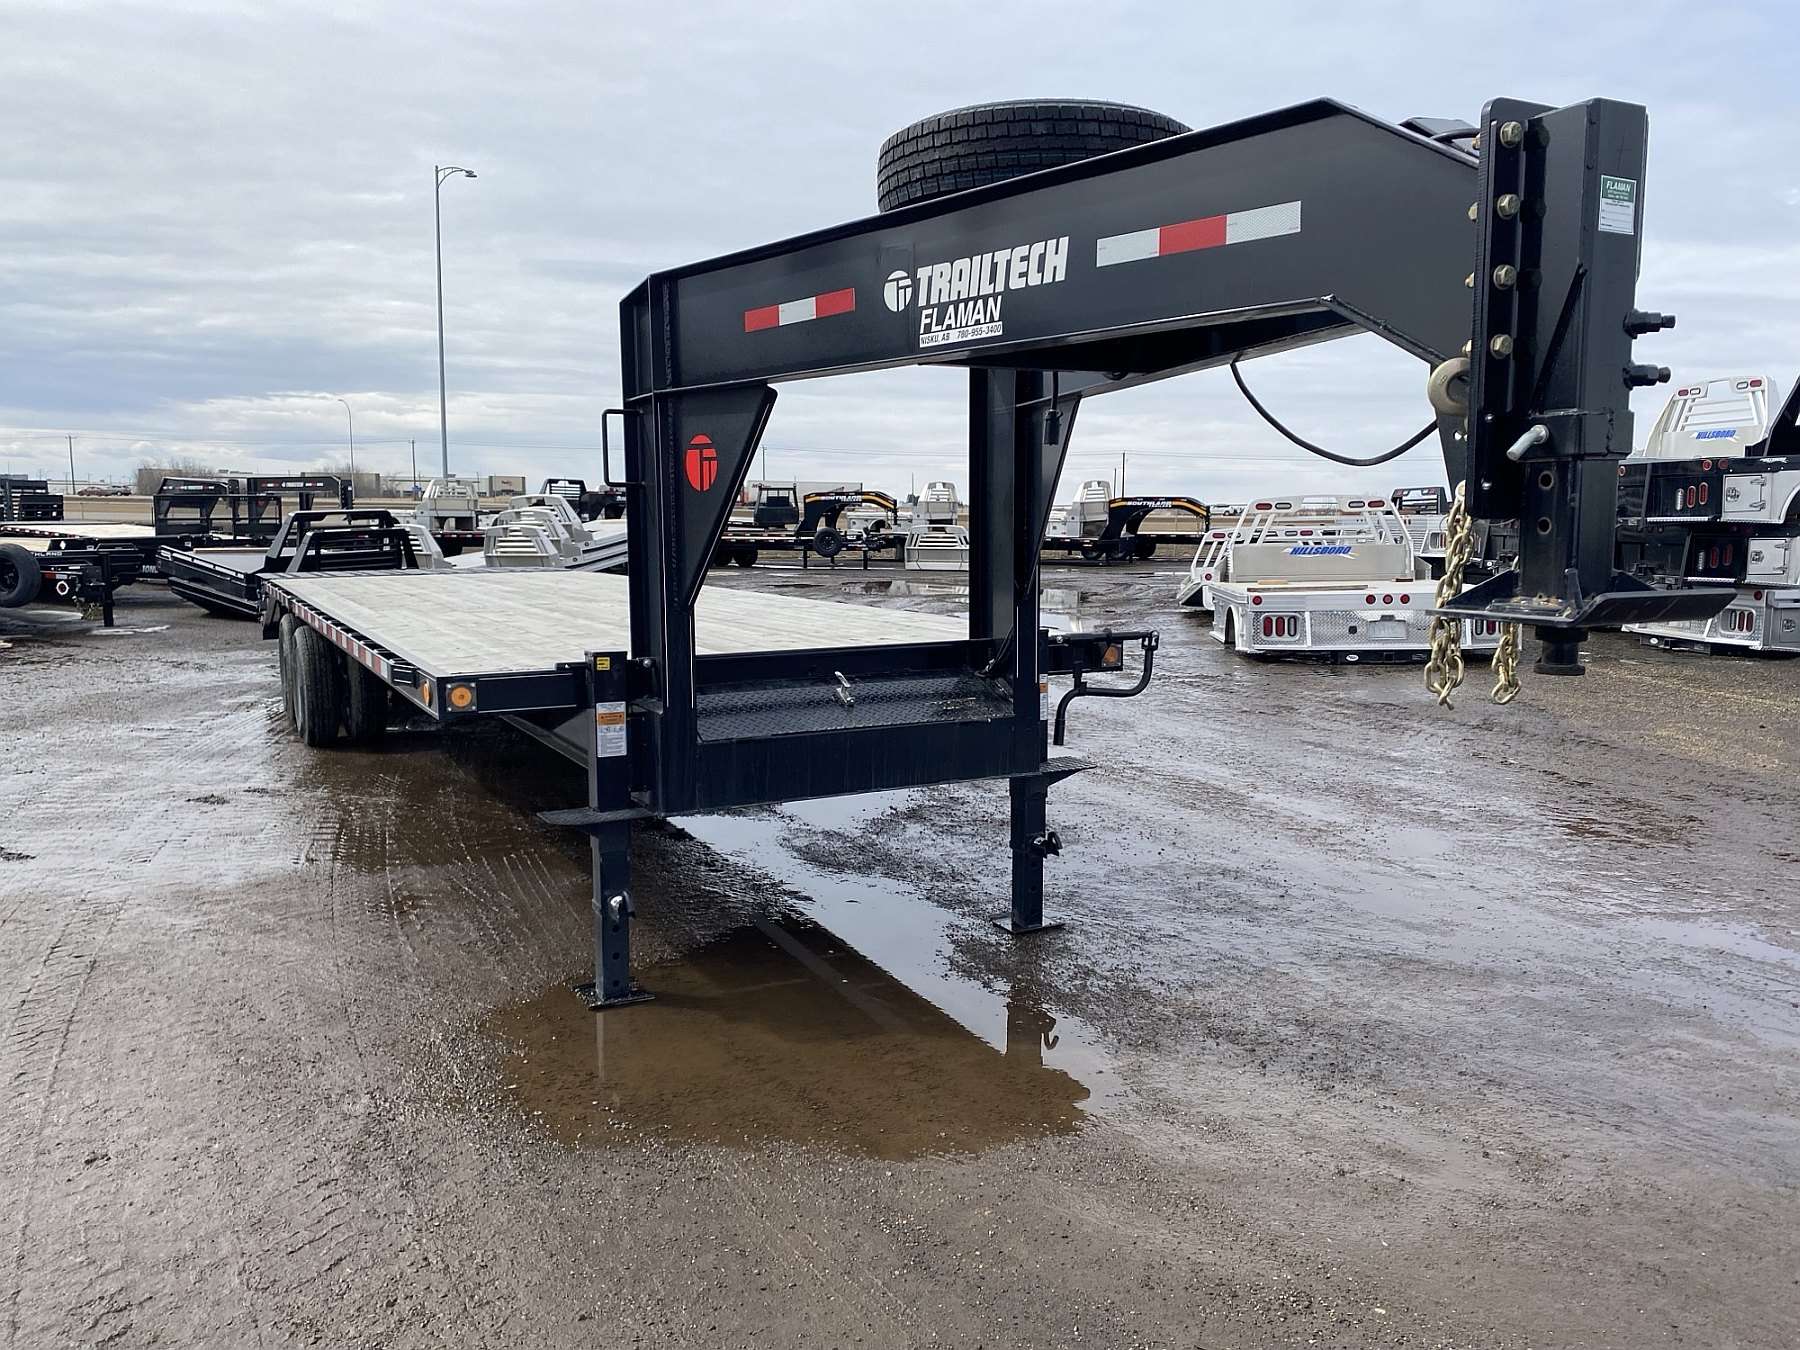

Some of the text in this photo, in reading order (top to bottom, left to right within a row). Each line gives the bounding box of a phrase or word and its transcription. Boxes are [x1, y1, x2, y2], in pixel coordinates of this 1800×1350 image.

[1606, 180, 1631, 192] FLAMAN
[917, 236, 1070, 307] TRAILTECH
[919, 295, 1002, 334] FLAMAN
[941, 332, 951, 342] AB
[957, 323, 1002, 339] 780-955-3400
[1696, 430, 1737, 439] HILLSBORO
[1290, 546, 1352, 555] HILLSBORO
